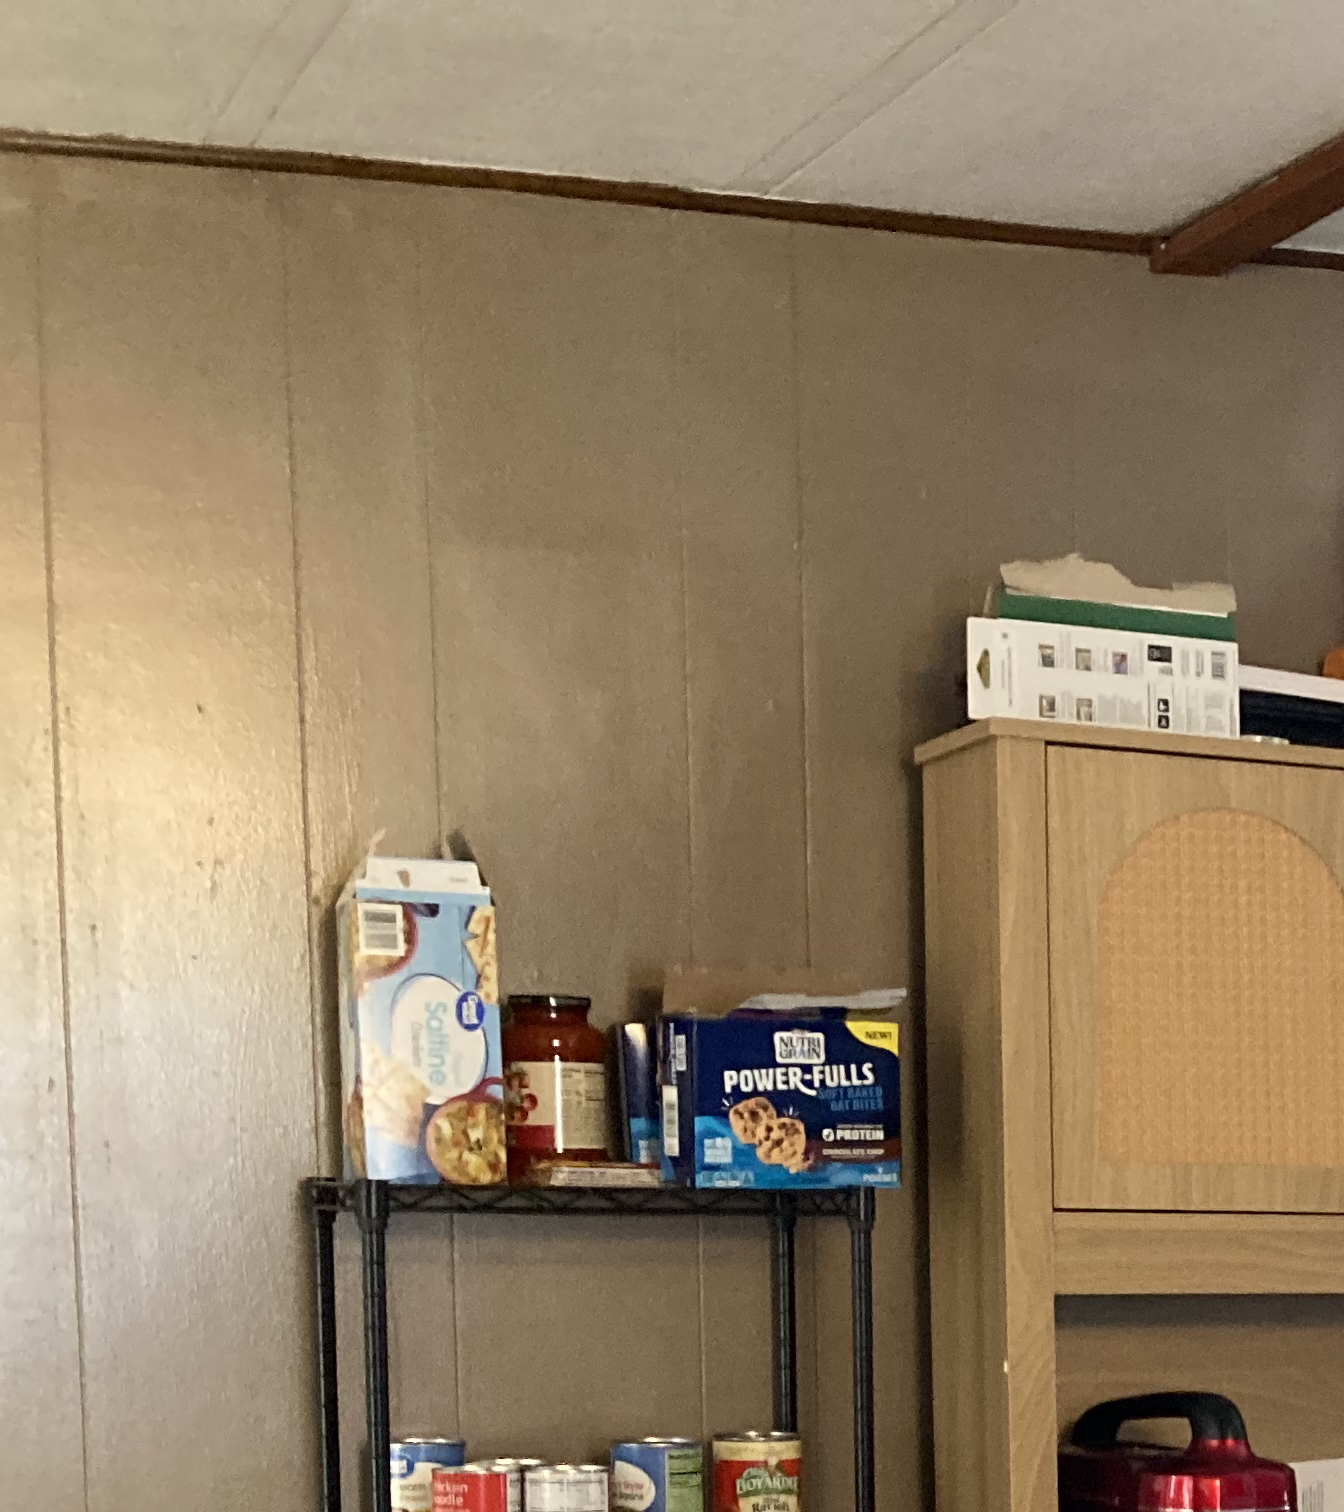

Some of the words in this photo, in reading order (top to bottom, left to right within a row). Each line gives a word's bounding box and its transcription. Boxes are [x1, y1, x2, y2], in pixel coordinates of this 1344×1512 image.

[865, 1031, 893, 1041] NEW!
[424, 1001, 451, 1085] Saltine
[779, 1036, 821, 1050] NUTRI
[779, 1047, 821, 1060] GRAIN
[723, 1062, 875, 1097] POWER-FULLS
[836, 1129, 885, 1141] PROTEIN
